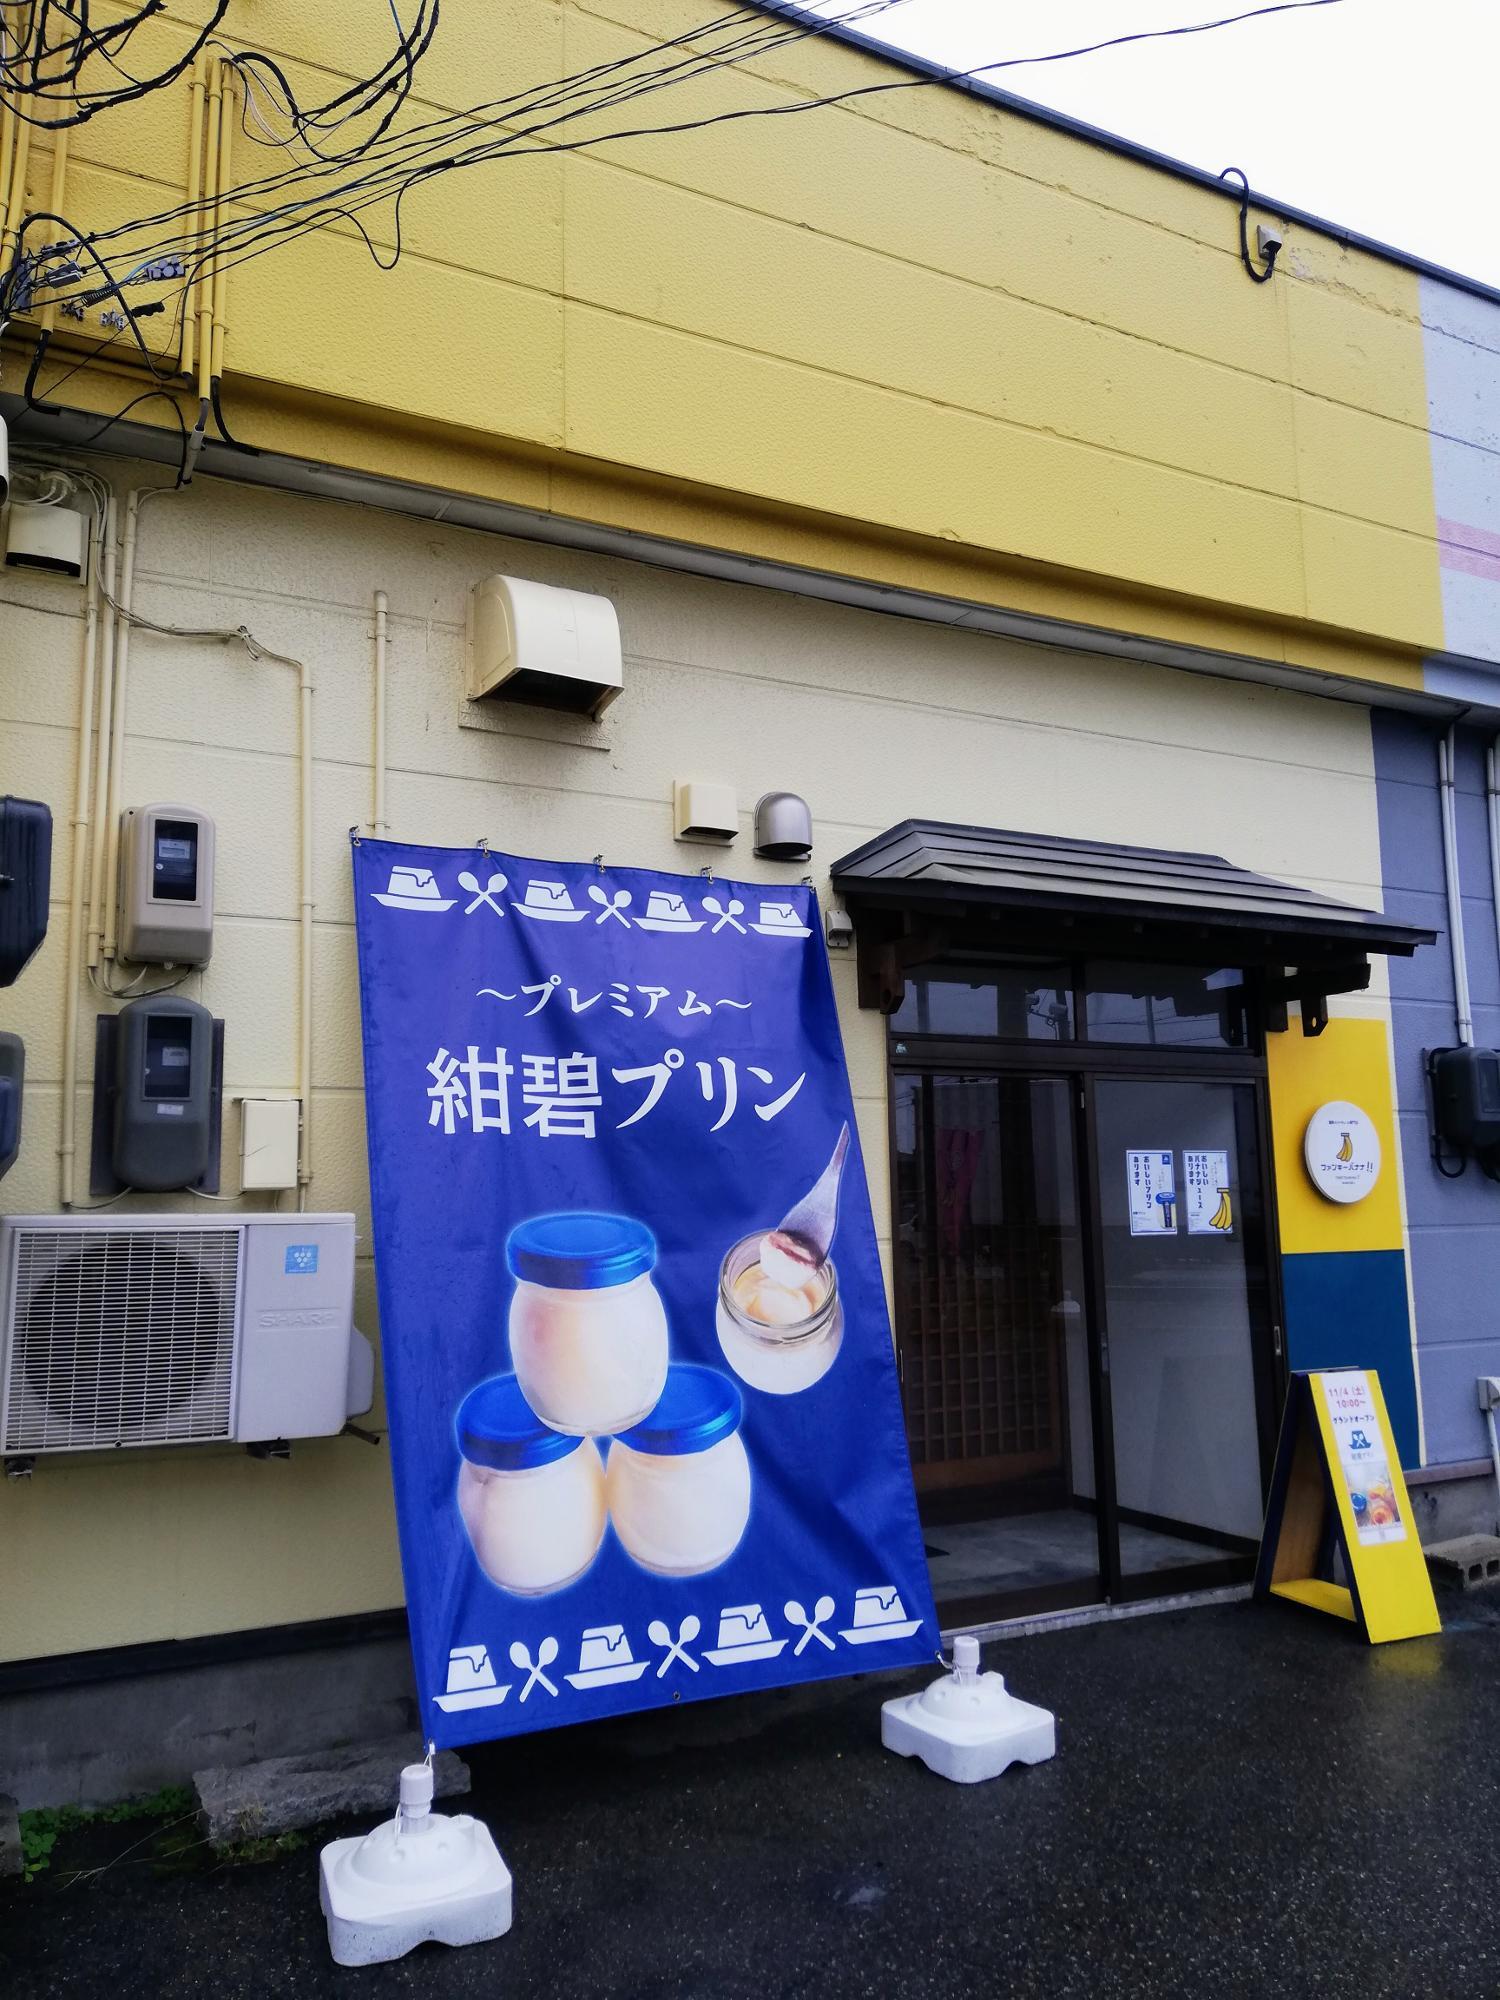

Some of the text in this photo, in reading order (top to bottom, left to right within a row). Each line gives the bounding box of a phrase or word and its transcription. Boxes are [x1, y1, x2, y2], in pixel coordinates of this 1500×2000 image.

[425, 1045, 807, 1139] 紺碧プリン
[1187, 1155, 1195, 1185] あります
[1194, 1155, 1203, 1209] バナナジュース
[1201, 1155, 1209, 1186] おいしい
